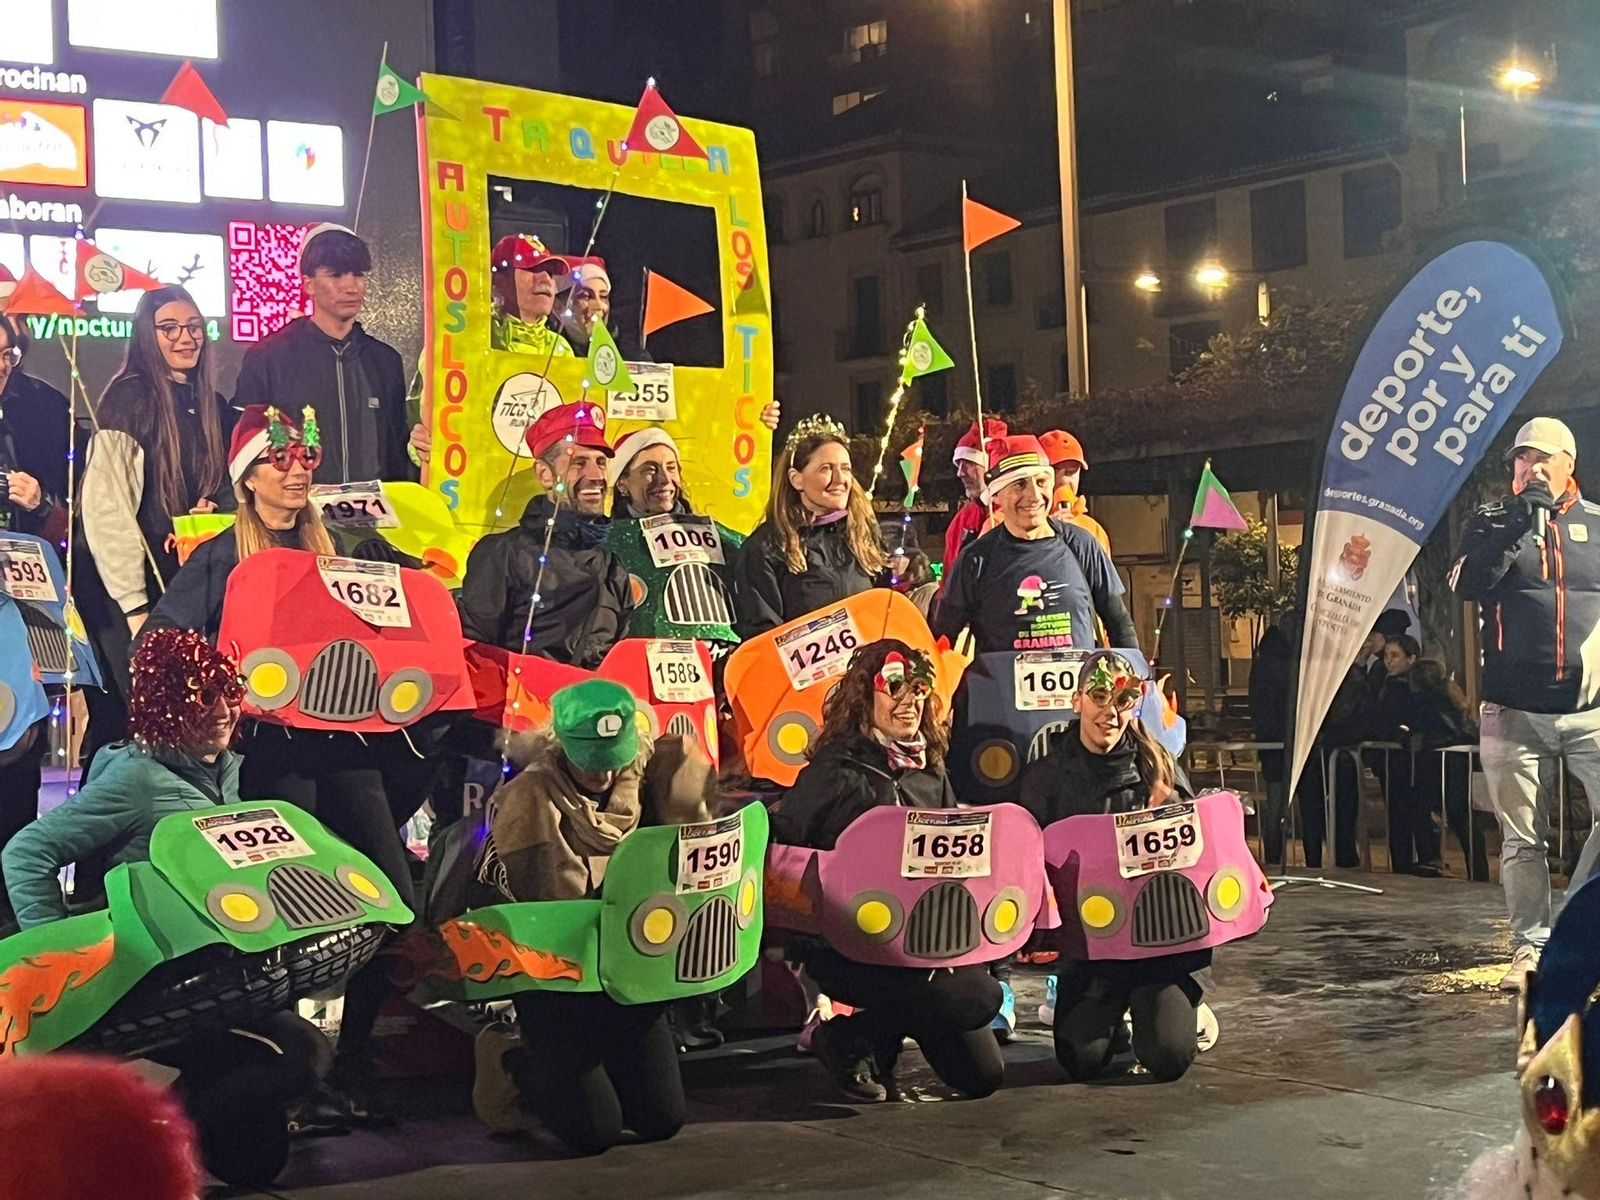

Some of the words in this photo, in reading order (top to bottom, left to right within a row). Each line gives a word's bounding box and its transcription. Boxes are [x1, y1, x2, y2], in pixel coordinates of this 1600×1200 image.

[729, 195, 755, 291] LOS
[1340, 285, 1482, 461] deporte,
[1433, 363, 1517, 466] para
[1500, 314, 1548, 358] tí
[733, 325, 759, 498] TICOS
[1384, 379, 1447, 466] por
[1440, 344, 1476, 384] y
[322, 499, 387, 519] 1971
[1324, 487, 1425, 531] deportes.granada.org
[654, 530, 717, 550] 1006
[331, 581, 401, 607] 1682
[790, 629, 857, 670] 1246
[1014, 635, 1074, 649] GRANADA
[656, 662, 701, 684] 1588
[1023, 671, 1075, 692] 160
[604, 719, 617, 732] L
[217, 826, 295, 851] 1928
[912, 834, 985, 858] 1658
[1125, 824, 1196, 857] 1659
[687, 839, 741, 874] 1590
